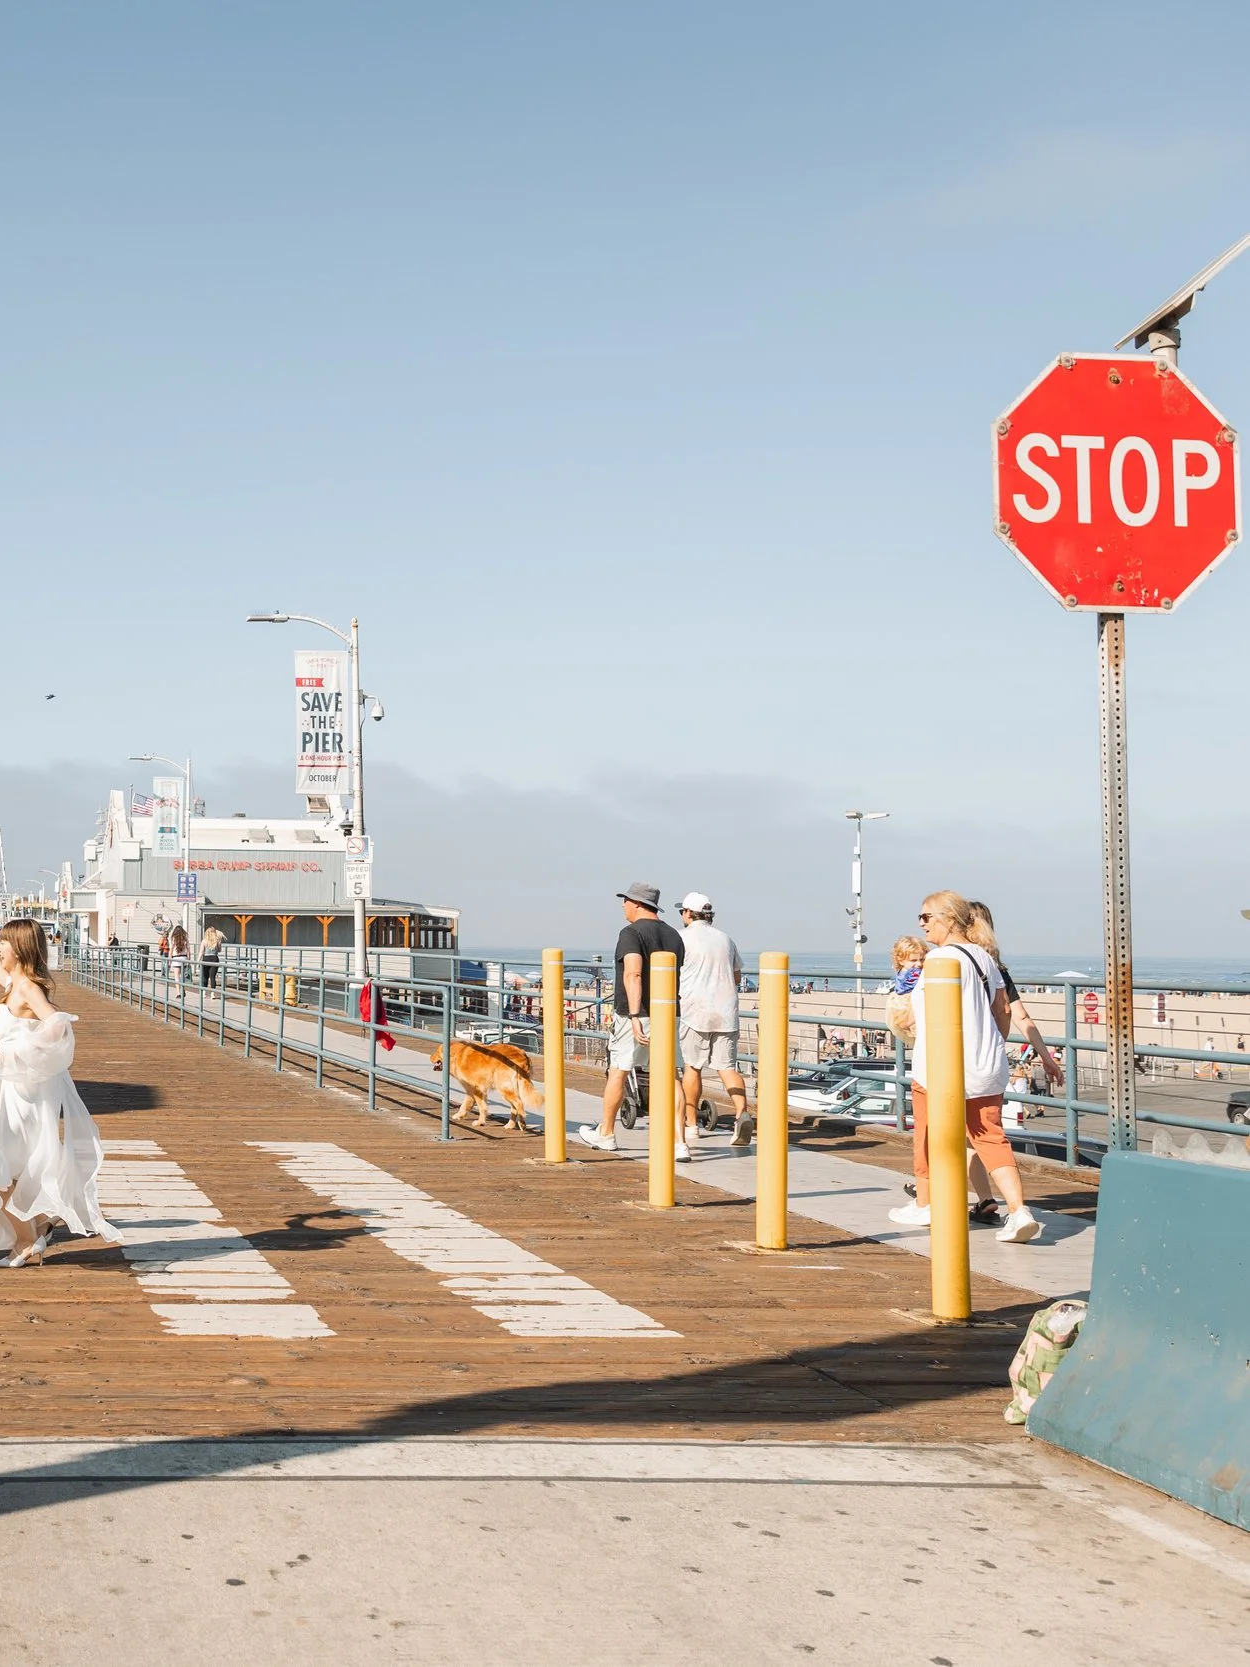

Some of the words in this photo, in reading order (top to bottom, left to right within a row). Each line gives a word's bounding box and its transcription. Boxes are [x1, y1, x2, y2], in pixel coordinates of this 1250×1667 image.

[1012, 432, 1221, 527] STOP
[301, 692, 343, 712] SAVE
[310, 715, 335, 729] THE
[302, 731, 344, 753] PIER
[308, 774, 337, 782] OCTOBER
[254, 861, 298, 872] SHRIMP
[353, 882, 363, 895] 5
[1, 902, 7, 910] 5
